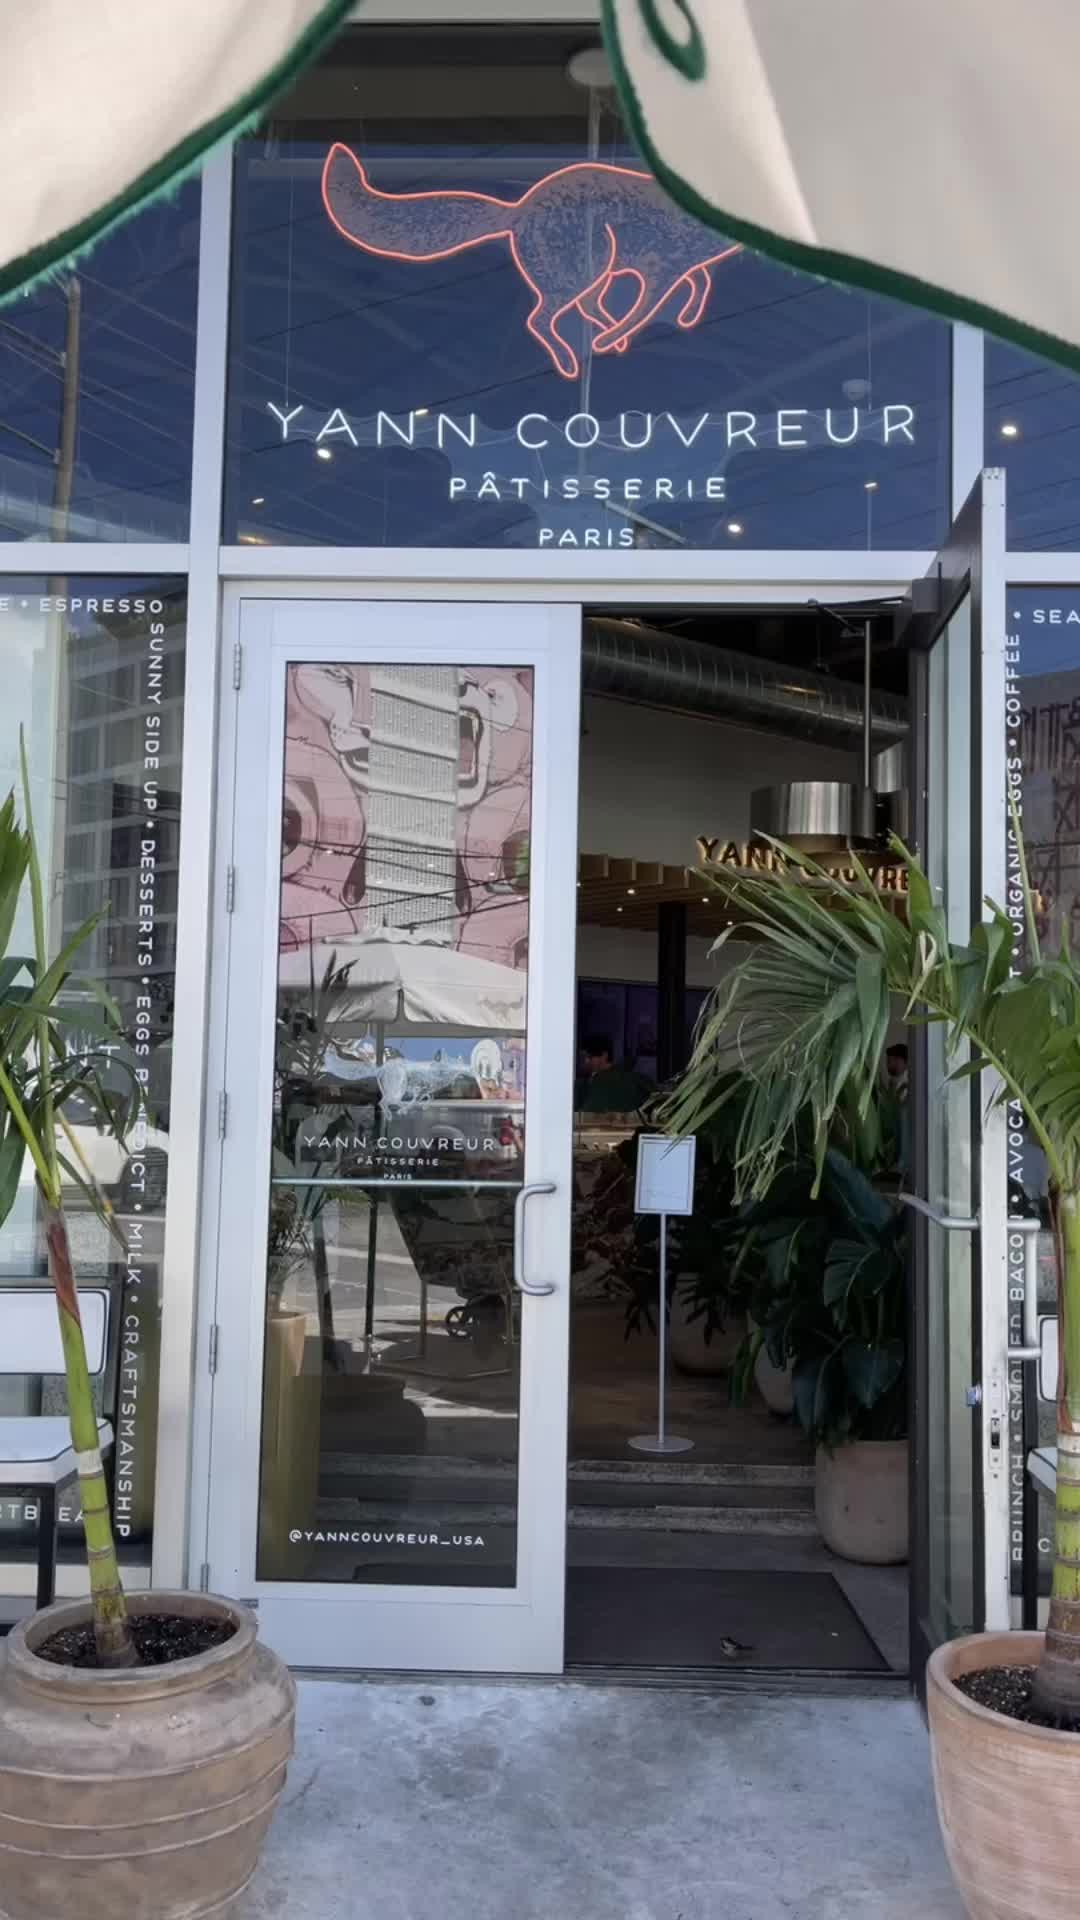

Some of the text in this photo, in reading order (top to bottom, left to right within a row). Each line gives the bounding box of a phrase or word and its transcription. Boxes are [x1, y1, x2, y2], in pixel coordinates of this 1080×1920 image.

[267, 402, 916, 448] YANN COUVREUR
[449, 471, 727, 499] PÂTISSERIE
[538, 527, 636, 547] PARIS
[39, 598, 163, 614] ESPRESSO
[1005, 634, 1021, 728] COFFEE
[1007, 757, 1022, 817] EGGS
[115, 623, 165, 1537] SUNNY SIDE UP DESSERTS EGGS BNEDICT MILK CRAFTSMANSHIP
[303, 1136, 496, 1151] YANN COUVREUR
[383, 1173, 413, 1181] PARIS
[1009, 1214, 1025, 1301] BACO
[1009, 1314, 1023, 1422] SMOED
[288, 1528, 486, 1546] @YANNCOUVREUR_USA
